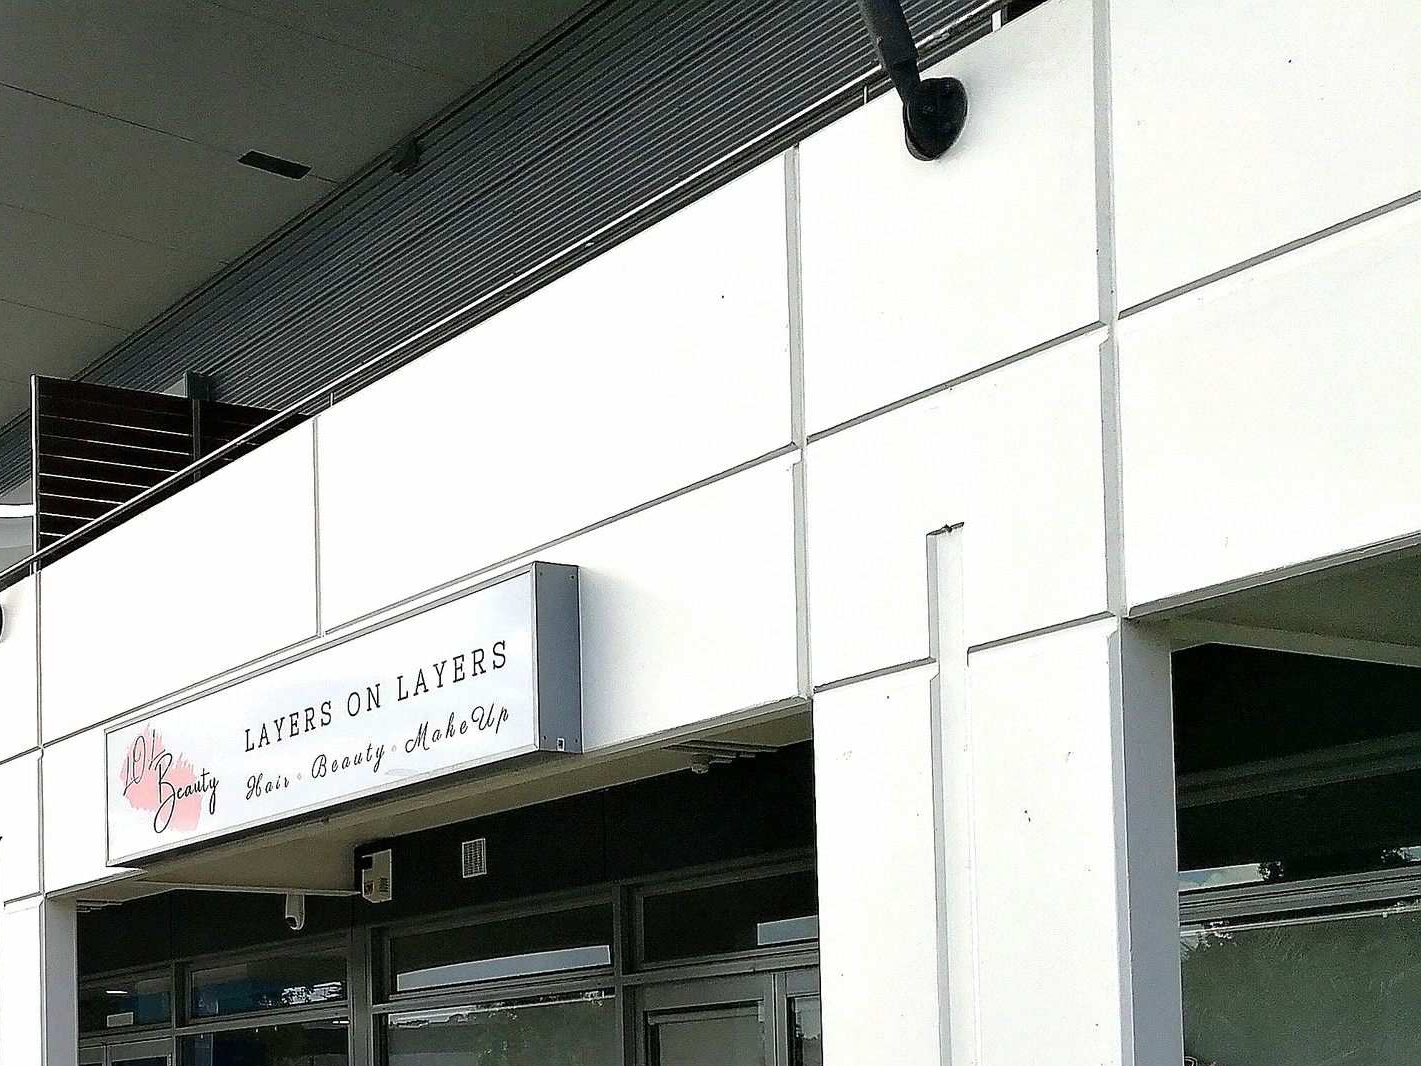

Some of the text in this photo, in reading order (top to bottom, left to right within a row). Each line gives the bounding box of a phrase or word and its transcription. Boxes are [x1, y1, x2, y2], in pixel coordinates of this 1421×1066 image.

[244, 640, 508, 753] LAYERS ON LAYERS
[154, 752, 220, 834] Beauty
[245, 773, 291, 801] Hair
[311, 740, 387, 780] Beauty
